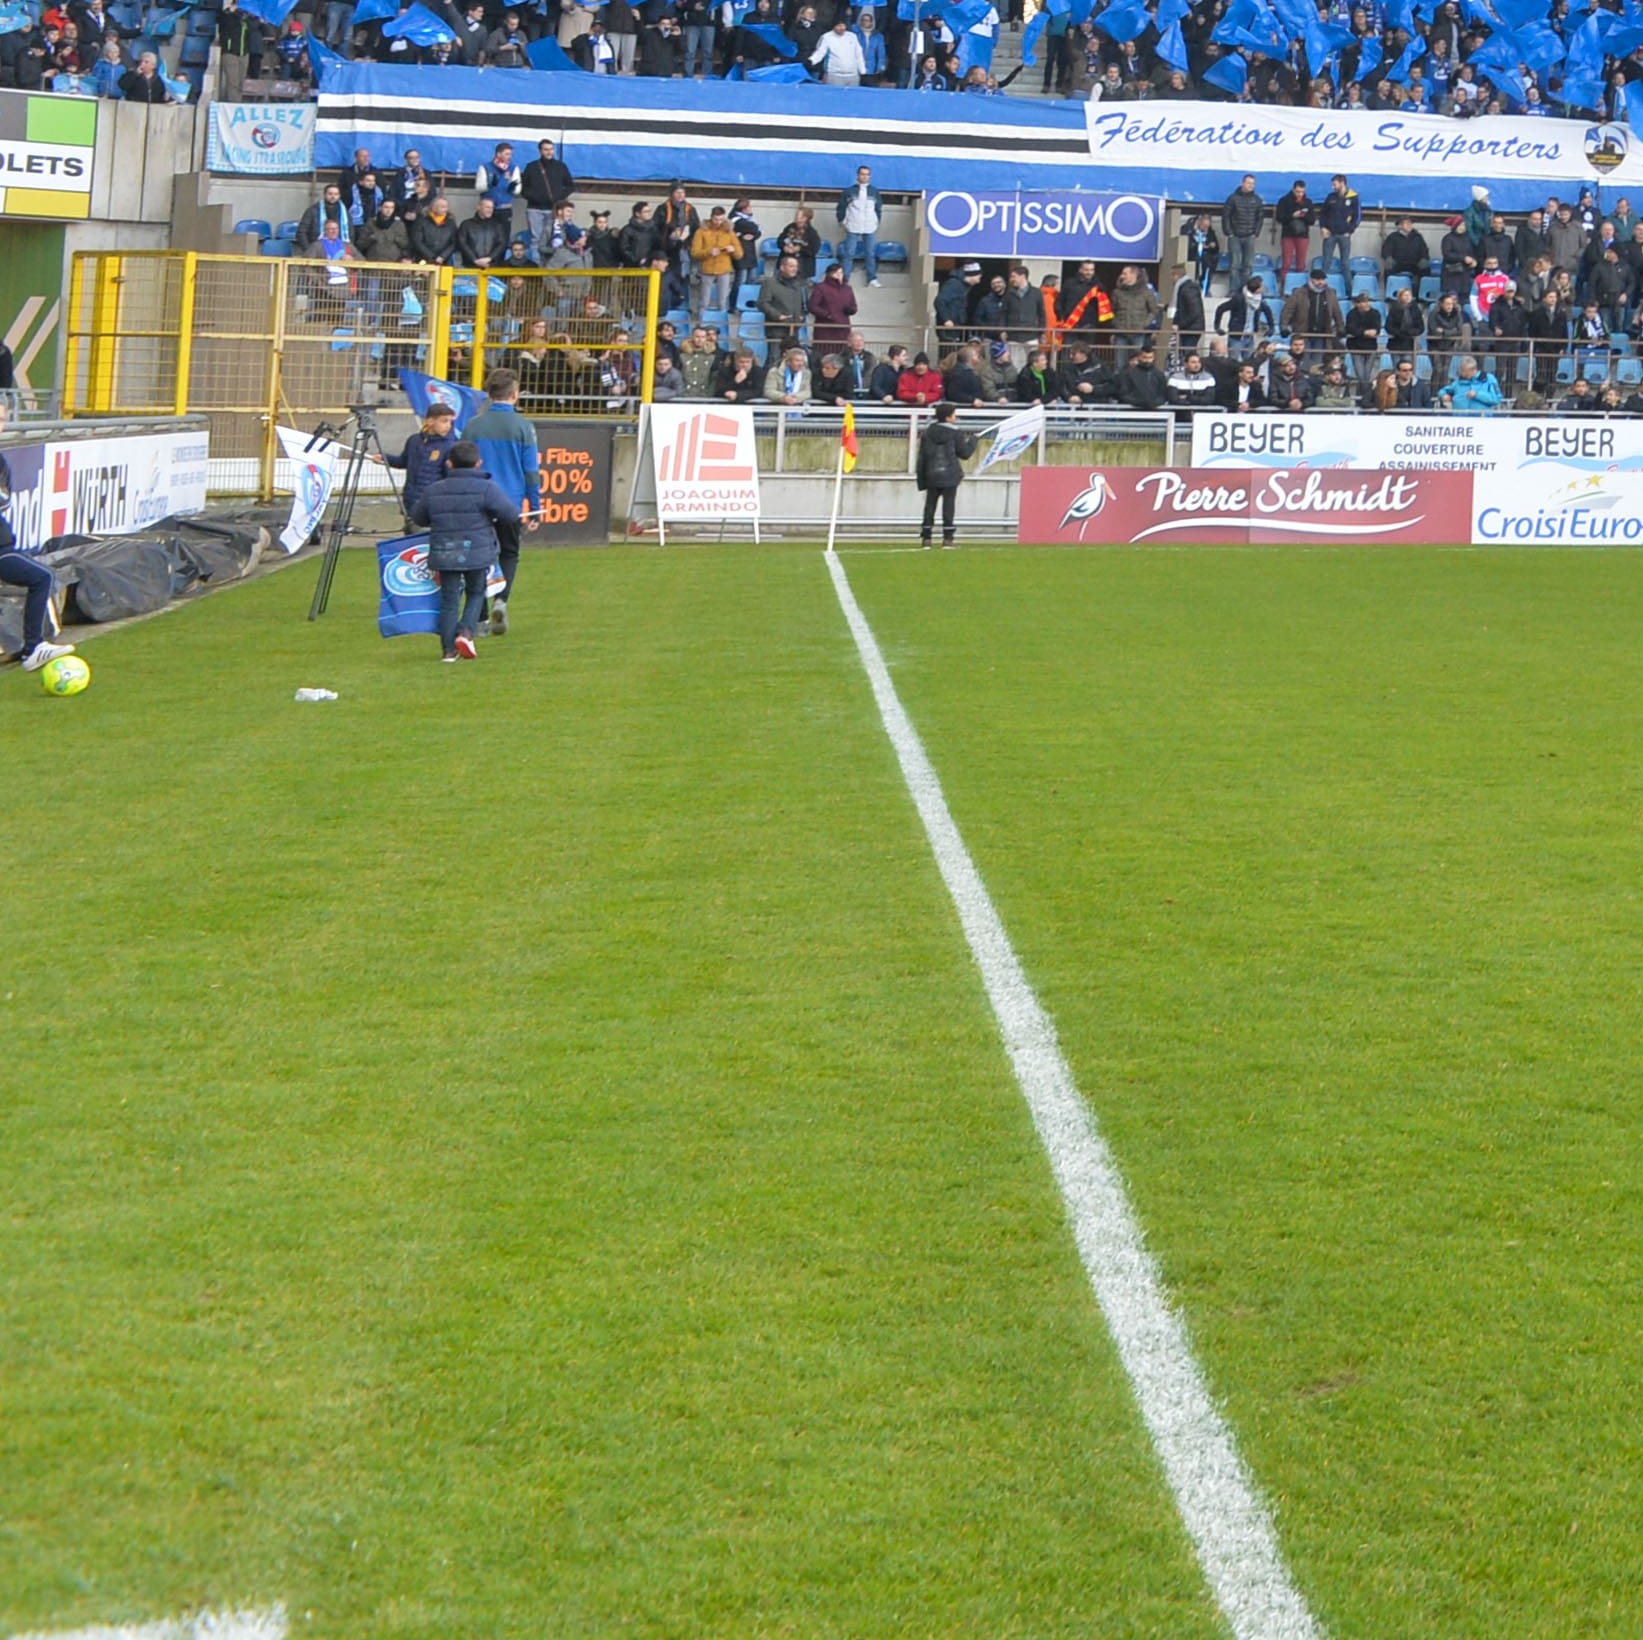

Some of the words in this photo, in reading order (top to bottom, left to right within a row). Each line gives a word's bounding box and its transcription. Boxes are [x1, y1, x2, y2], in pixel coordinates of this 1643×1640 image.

[230, 106, 304, 130] ALLEZ
[1096, 111, 1285, 150] Fédération
[1301, 123, 1353, 150] des
[1373, 122, 1561, 162] Supporters
[927, 191, 1153, 242] OPTISSIMO
[1209, 422, 1304, 454] BEYER
[1405, 426, 1473, 438] SANITAIRE
[1526, 427, 1614, 458] BEYER
[546, 447, 594, 467] Fibre,
[1393, 443, 1484, 455] COUVERTURE
[538, 469, 592, 493] 00%
[1136, 472, 1248, 511] Pierre
[1256, 471, 1420, 513] Schmidt
[661, 501, 758, 512] ARMINDO
[662, 489, 756, 500] JOAQUIM
